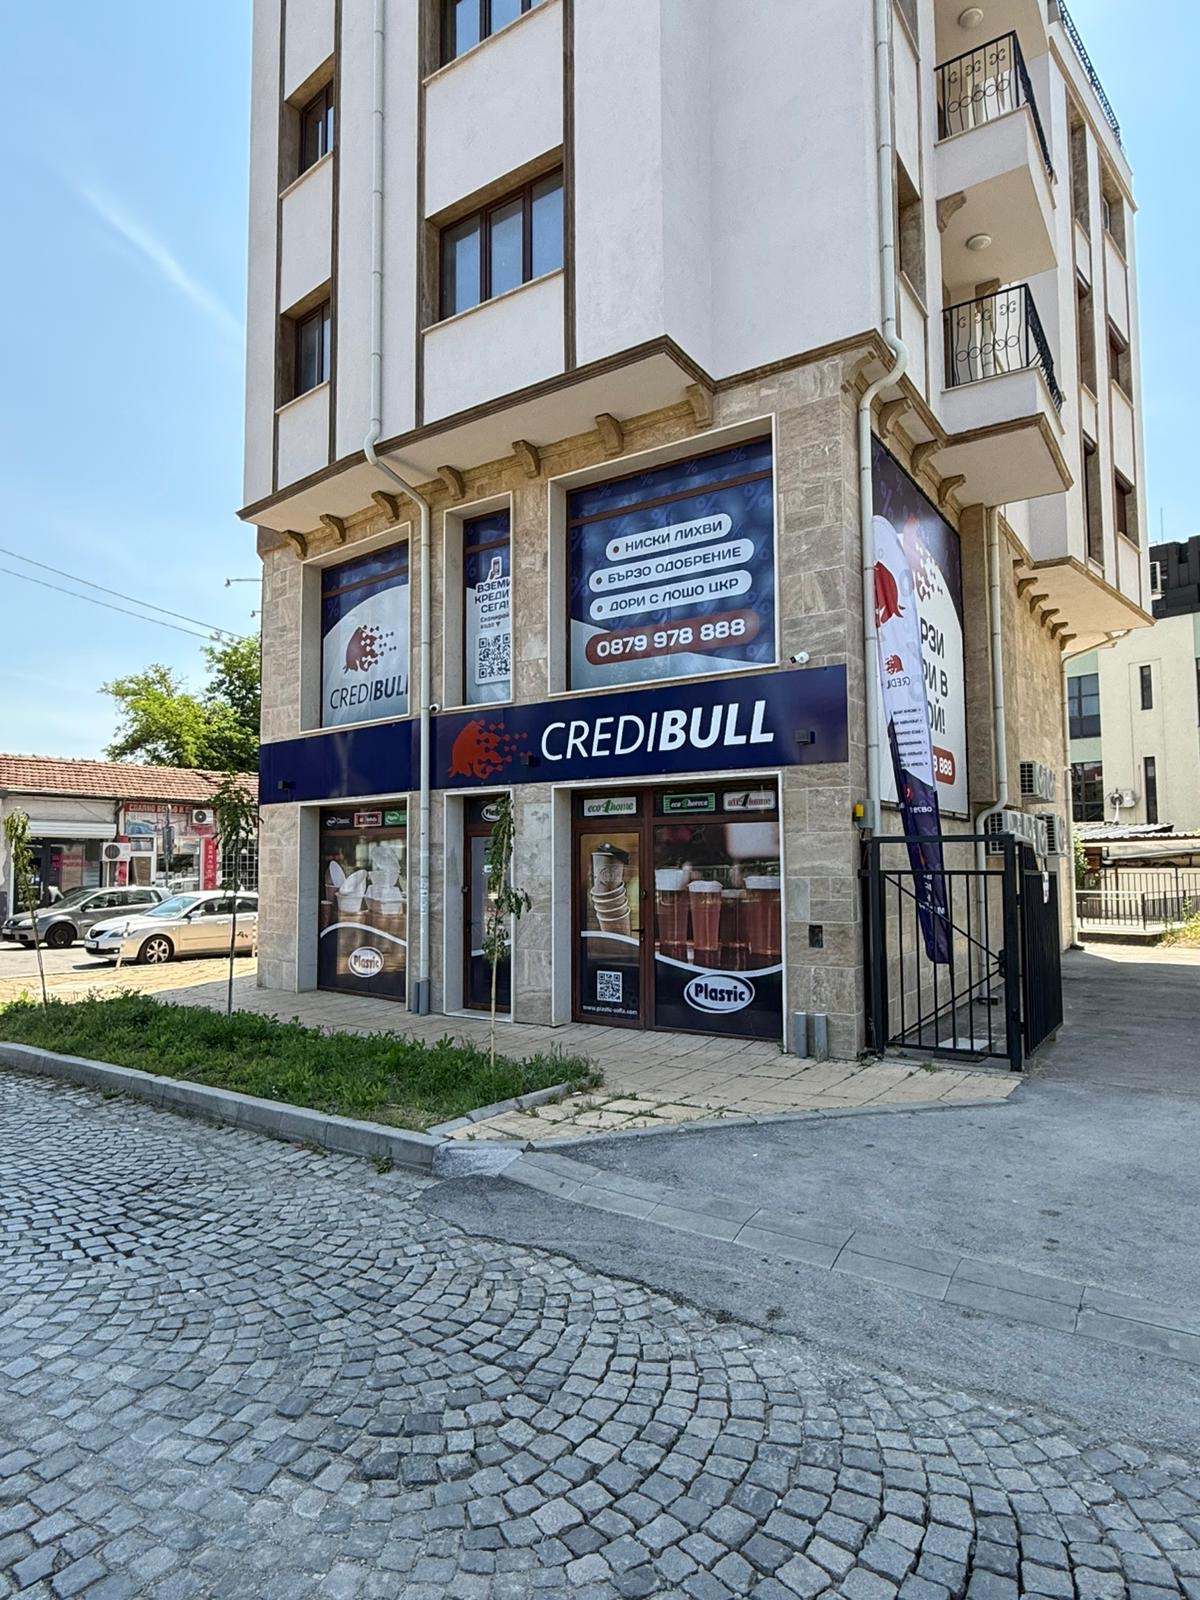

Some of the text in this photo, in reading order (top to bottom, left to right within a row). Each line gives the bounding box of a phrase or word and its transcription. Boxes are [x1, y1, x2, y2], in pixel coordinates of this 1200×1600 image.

[625, 520, 722, 552] НИСКИ ЛИХВИ
[608, 546, 742, 583] БЪРЗО ОДОБРЕНИЕ
[609, 578, 739, 612] ДОРИ С ЛОШО ЦКР
[596, 618, 746, 657] 0879 978 888
[941, 669, 948, 698] В
[541, 700, 774, 761] CREDIBULL
[939, 756, 953, 777] 888
[353, 955, 380, 968] Plastic
[694, 983, 746, 1002] Plastic
